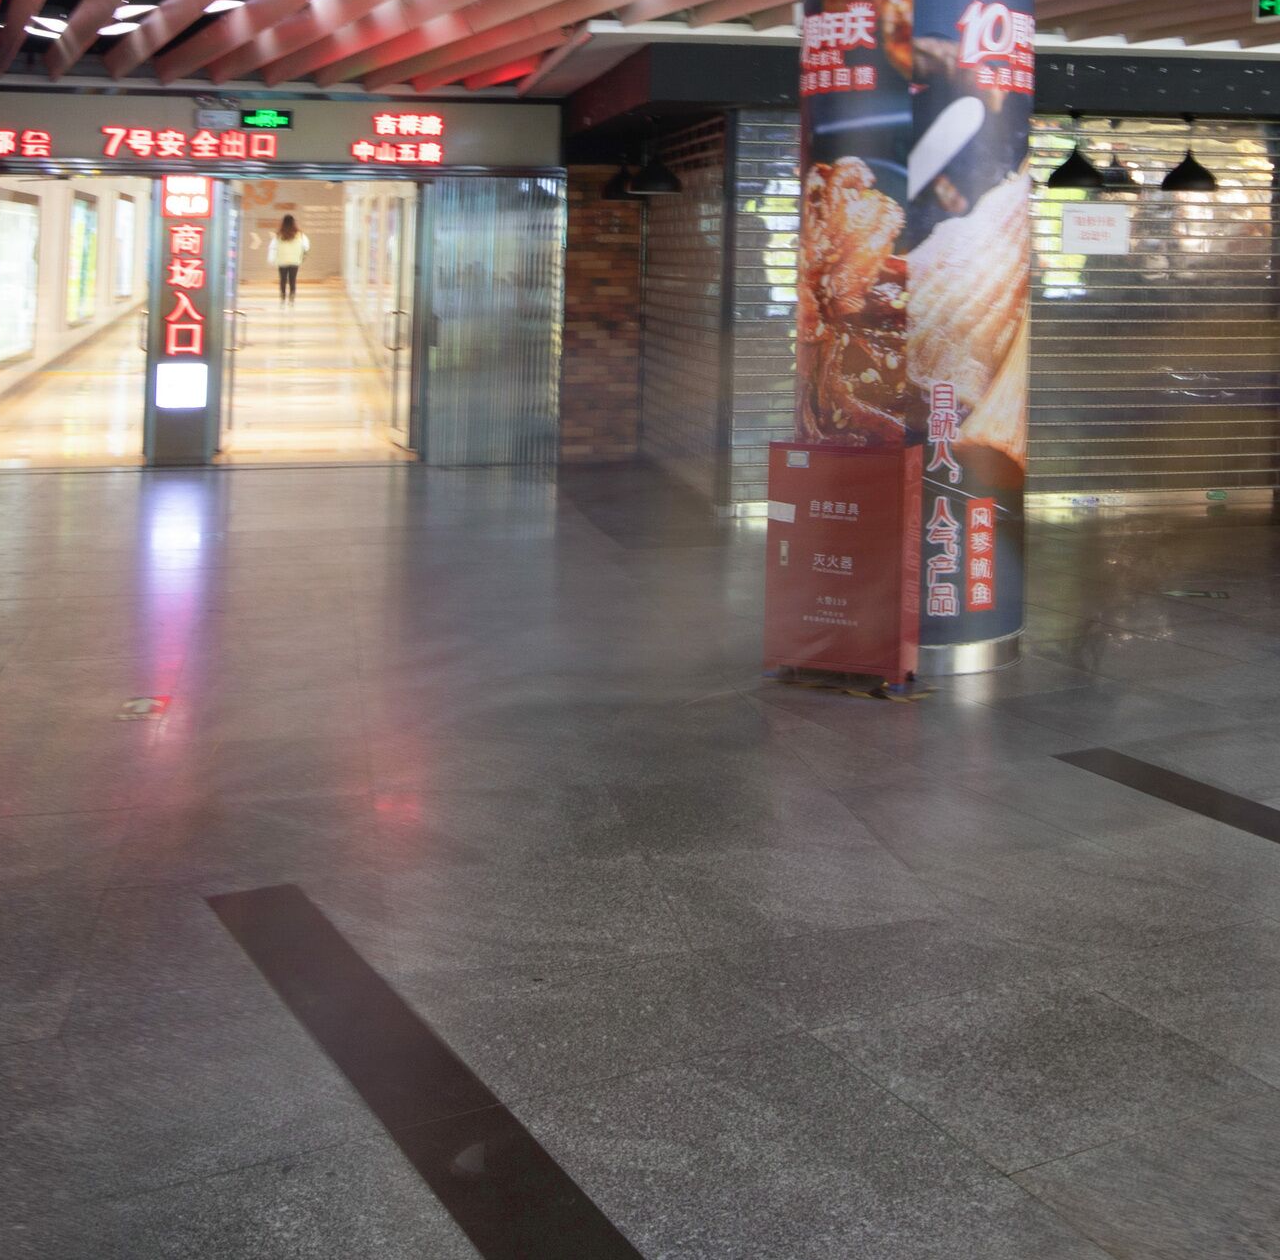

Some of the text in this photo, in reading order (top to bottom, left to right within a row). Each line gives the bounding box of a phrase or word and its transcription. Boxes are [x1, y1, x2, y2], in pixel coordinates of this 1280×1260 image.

[101, 124, 278, 160] 7号安全出口
[351, 139, 443, 164] 中山五路
[164, 223, 207, 357] 商场入口
[812, 553, 854, 570] 灭火器
